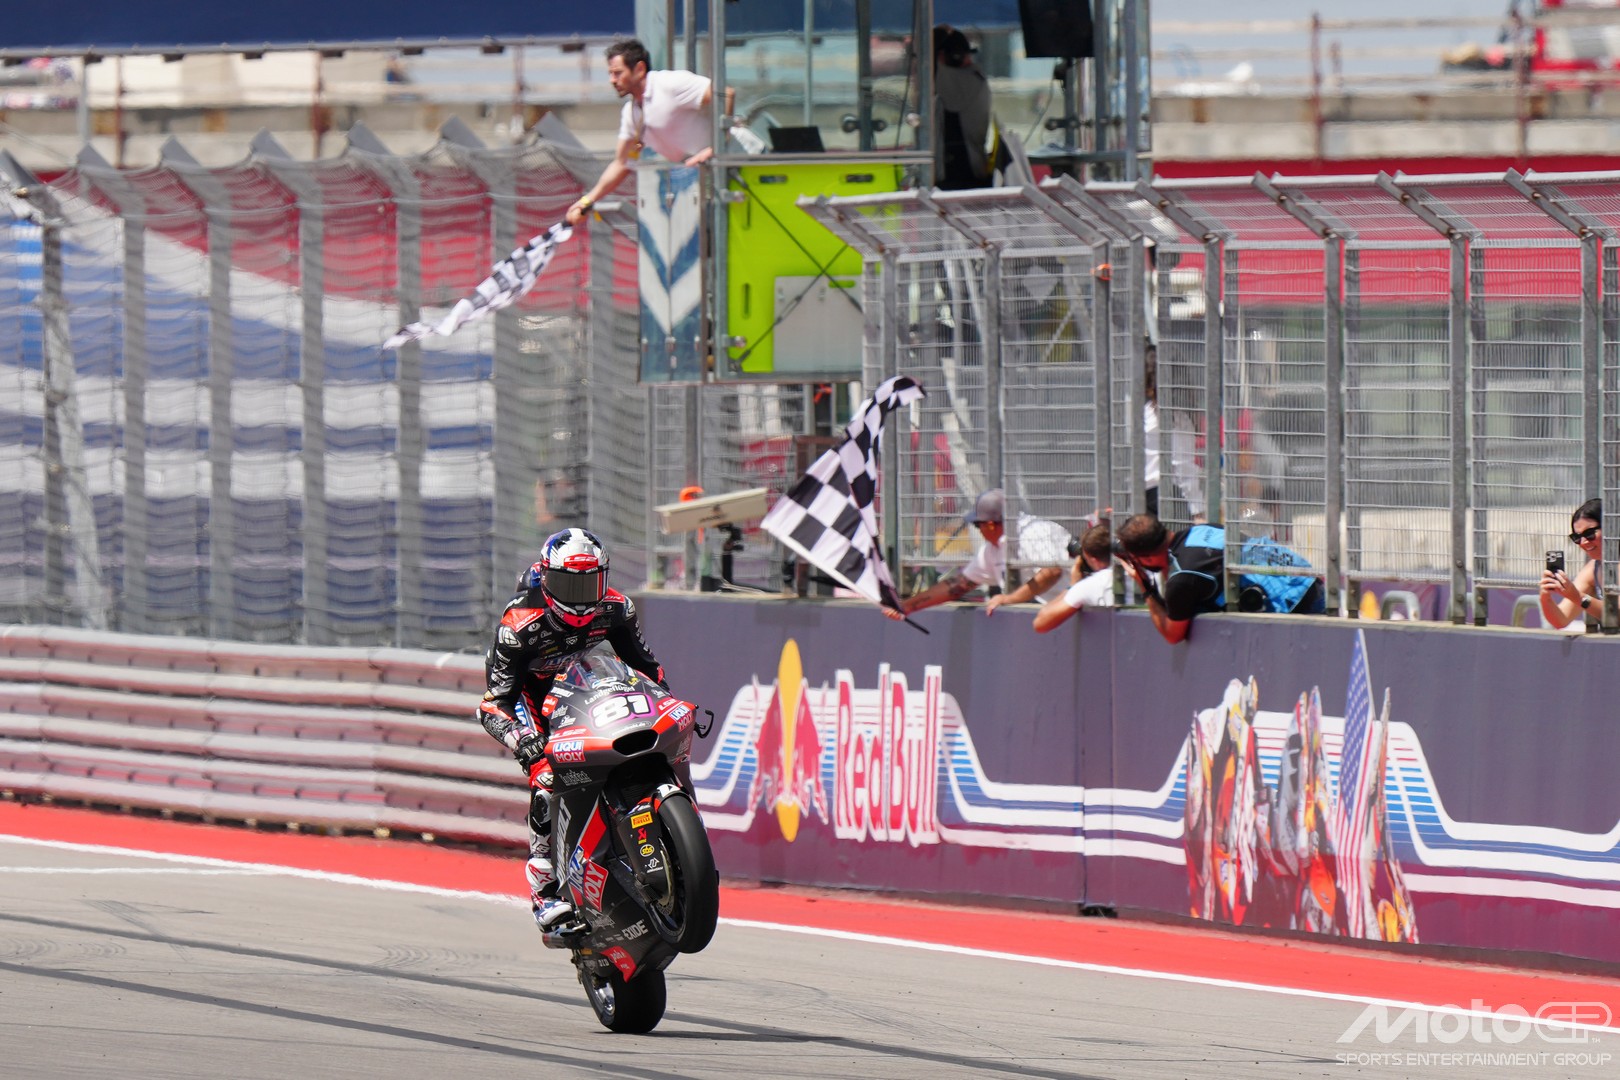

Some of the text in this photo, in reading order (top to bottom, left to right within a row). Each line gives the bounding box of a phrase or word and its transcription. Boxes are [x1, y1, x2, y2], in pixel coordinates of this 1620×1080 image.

[584, 685, 635, 705] Landgeflügel
[592, 694, 650, 728] 81
[669, 705, 691, 721] LIQUI
[554, 741, 582, 753] LIQUI
[555, 752, 582, 762] MOLY
[584, 862, 605, 907] MOLY
[621, 919, 648, 941] EXIDE
